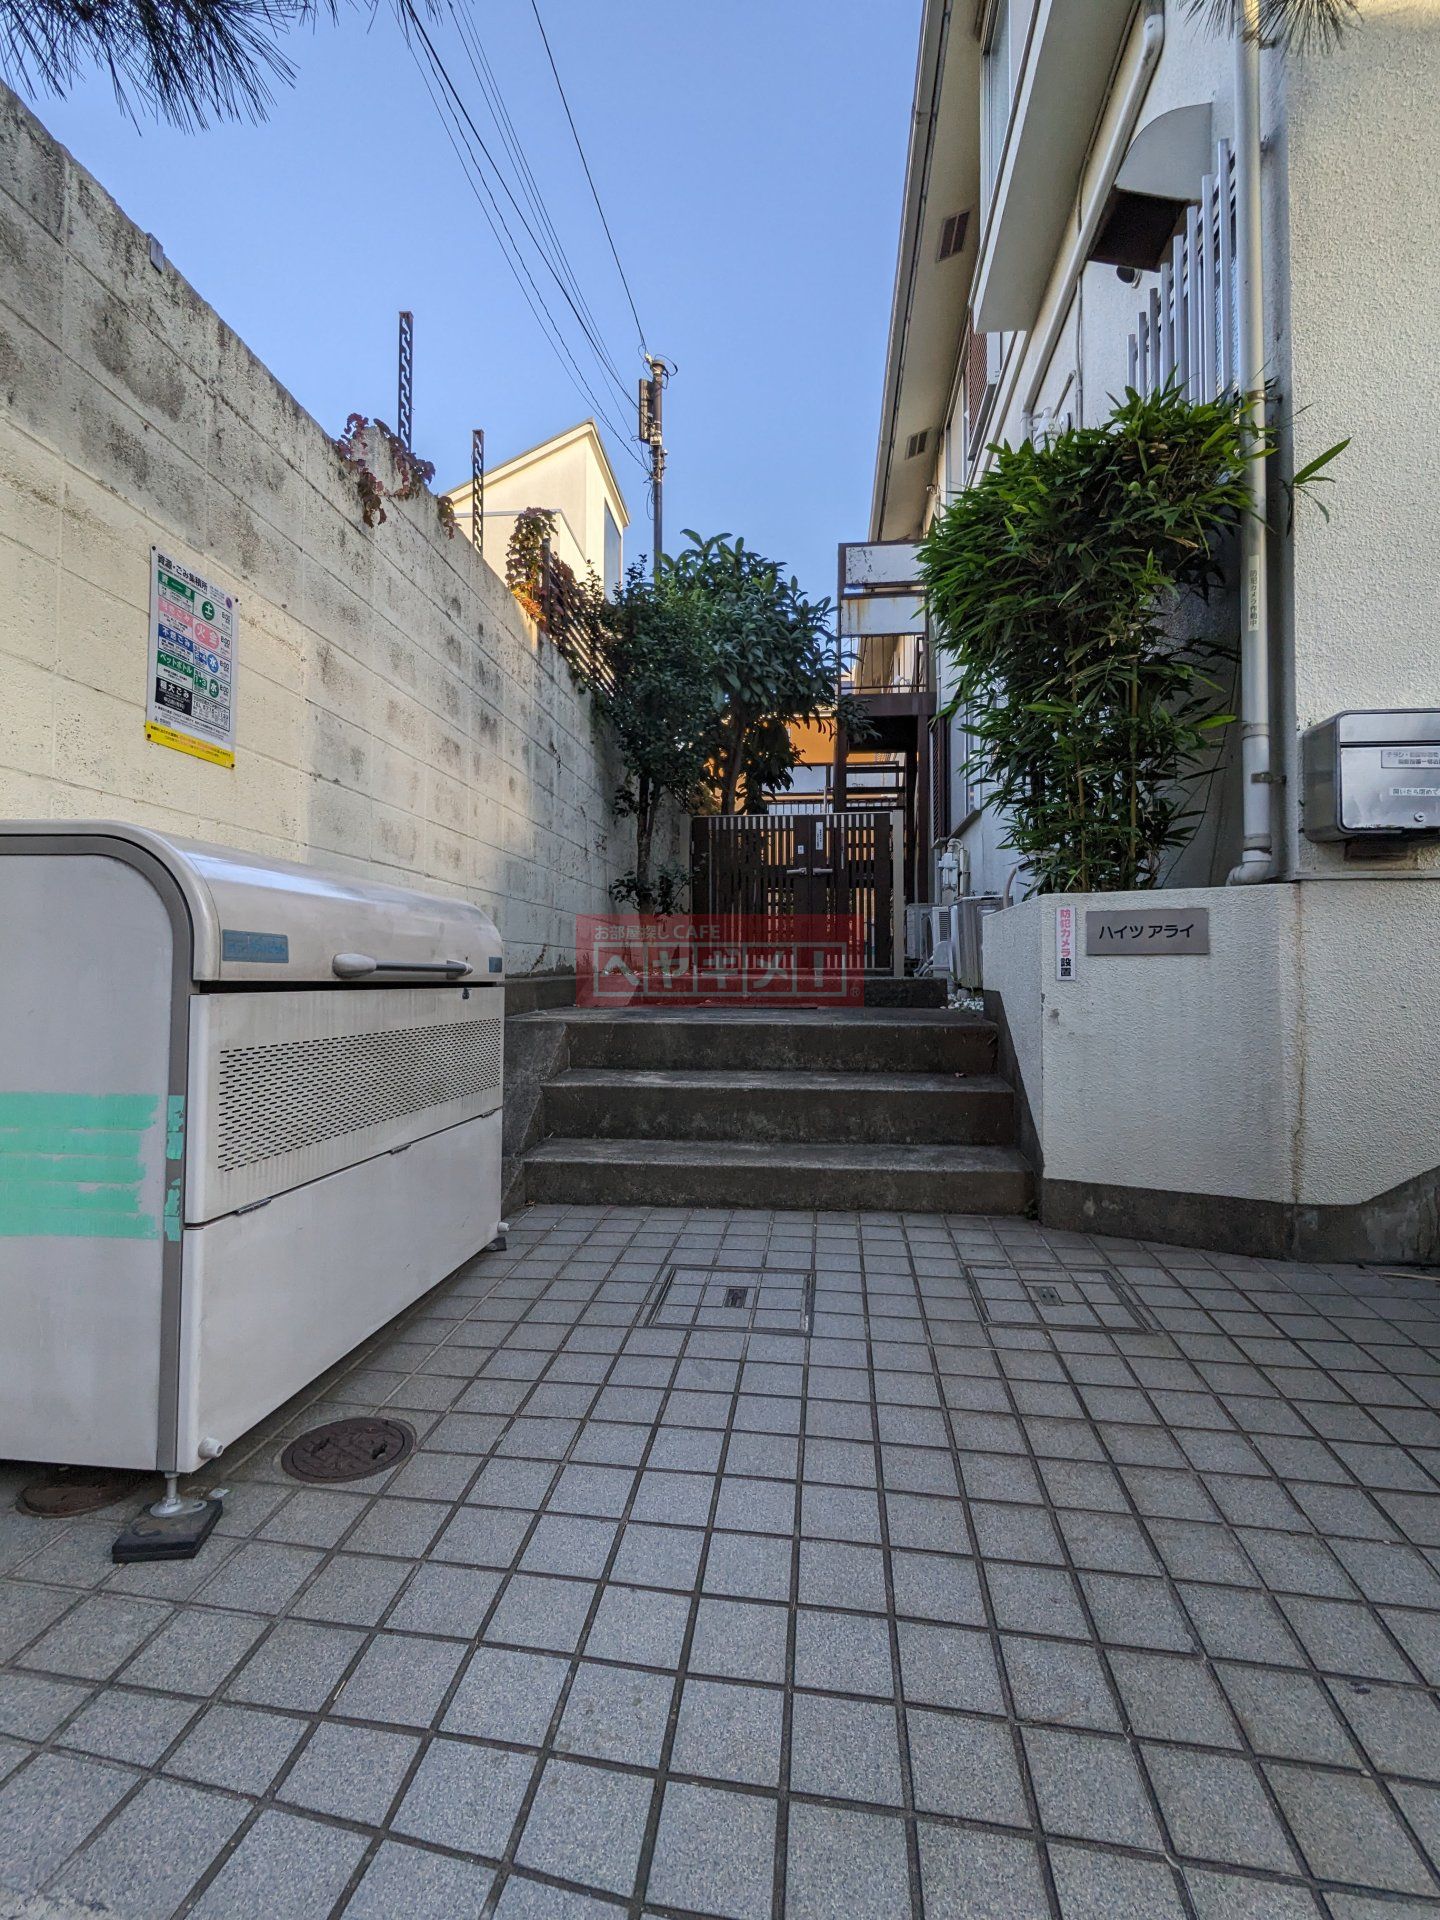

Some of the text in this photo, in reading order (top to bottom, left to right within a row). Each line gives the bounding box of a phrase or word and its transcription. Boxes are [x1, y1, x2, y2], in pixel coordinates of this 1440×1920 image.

[160, 653, 193, 674] ペットボトル
[1099, 923, 1195, 940] ハイツ アライ
[1060, 909, 1072, 977] 防犯カメラ設置
